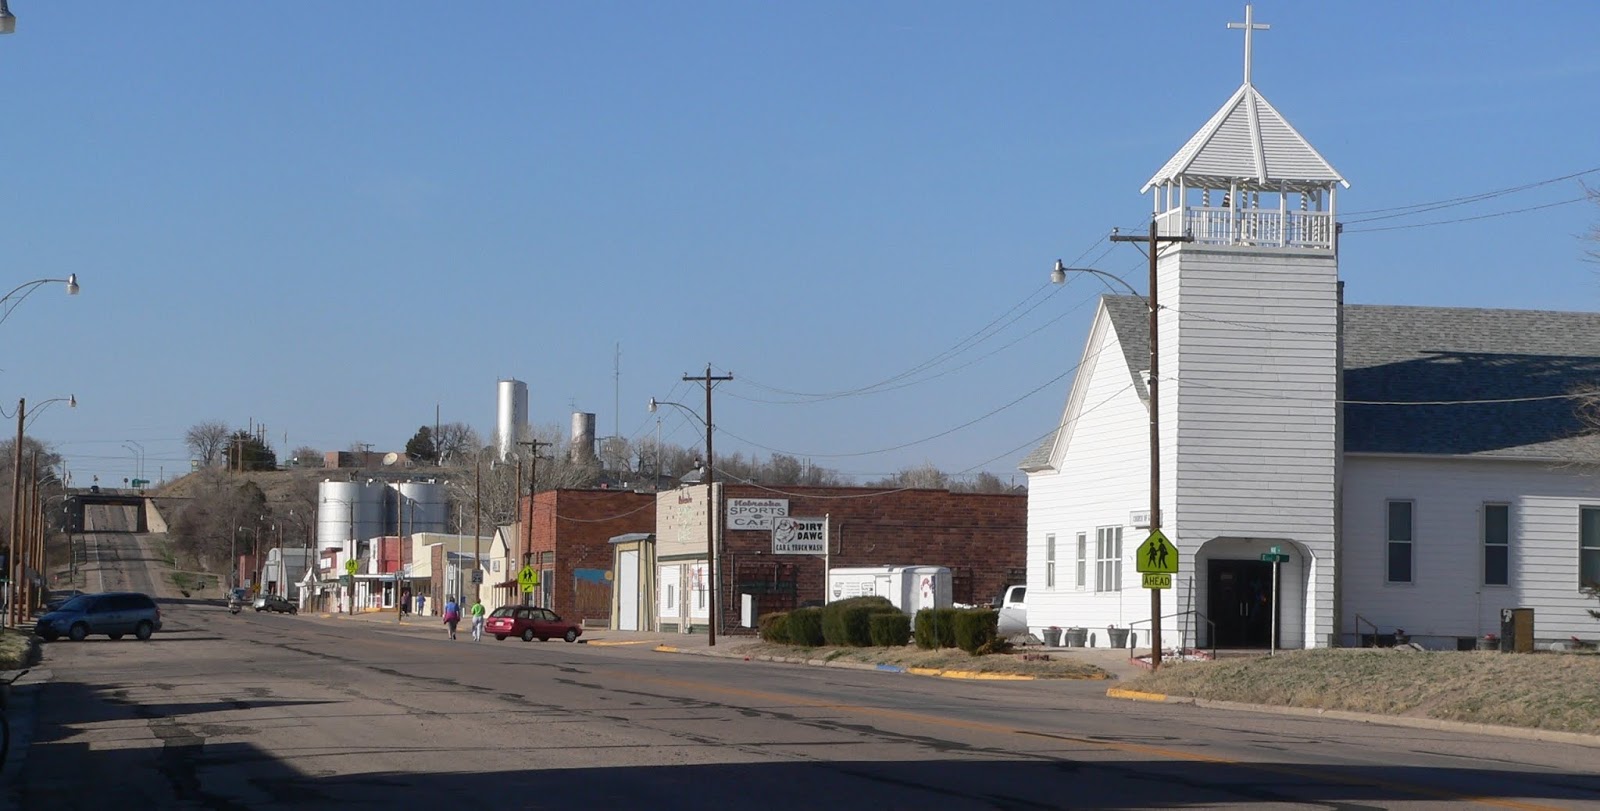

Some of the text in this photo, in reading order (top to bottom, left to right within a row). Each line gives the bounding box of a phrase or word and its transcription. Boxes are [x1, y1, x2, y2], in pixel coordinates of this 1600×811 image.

[730, 507, 785, 516] SPORTS
[799, 523, 823, 531] DIRT
[797, 532, 823, 541] DAWG
[776, 544, 787, 552] CAR
[792, 544, 808, 552] TRUCK
[809, 544, 823, 552] WASH
[1144, 576, 1170, 586] AHEAD
